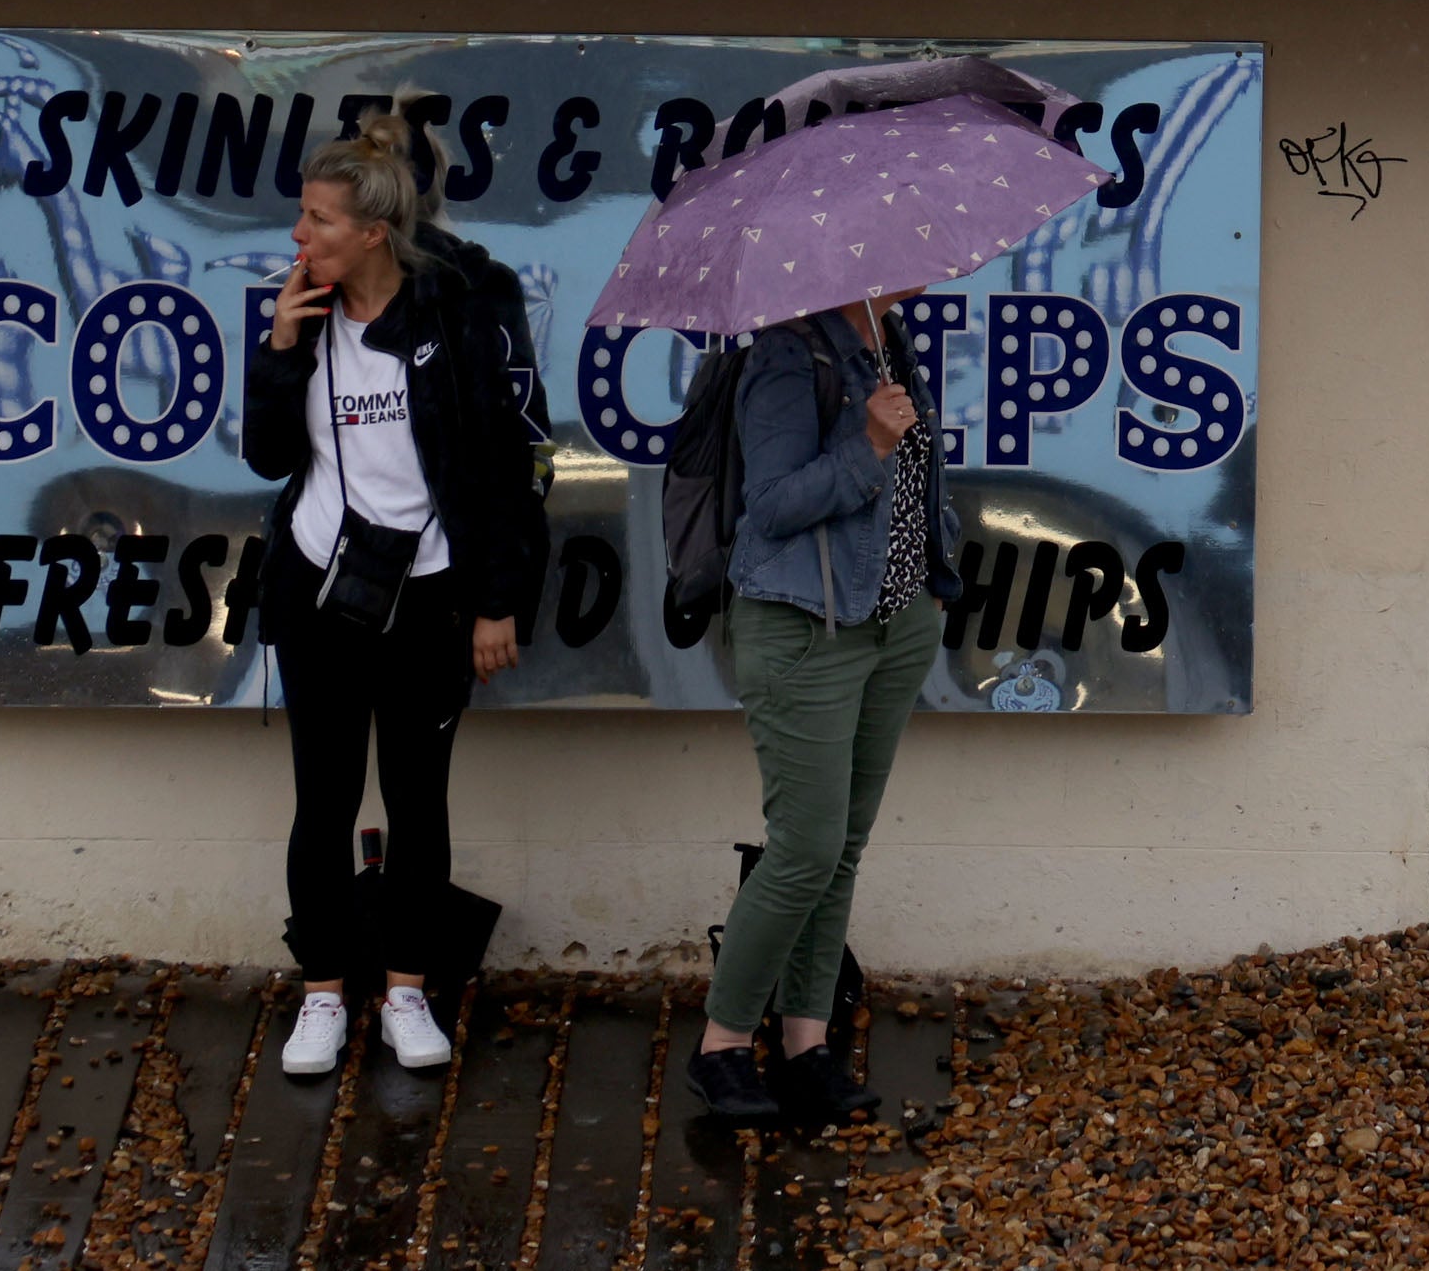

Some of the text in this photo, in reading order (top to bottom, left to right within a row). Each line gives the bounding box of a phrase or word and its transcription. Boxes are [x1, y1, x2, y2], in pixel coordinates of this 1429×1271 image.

[537, 96, 601, 203] &
[334, 389, 406, 414] TOMMY
[360, 409, 407, 425] JEANS
[577, 292, 1247, 472] CIPS
[943, 540, 1185, 653] HIPS
